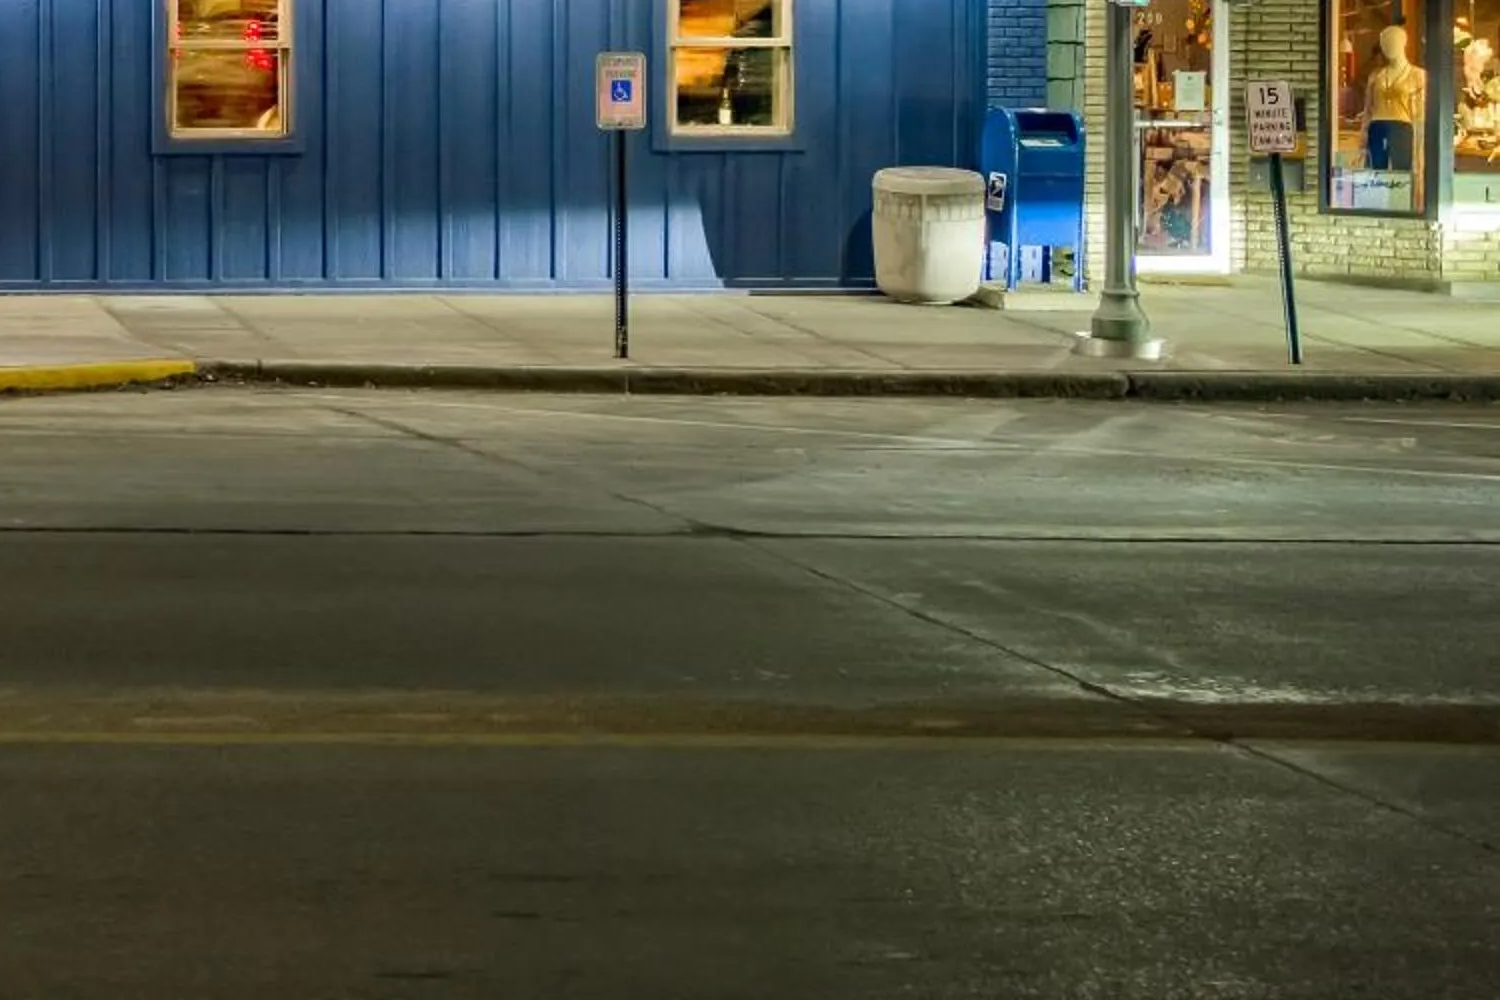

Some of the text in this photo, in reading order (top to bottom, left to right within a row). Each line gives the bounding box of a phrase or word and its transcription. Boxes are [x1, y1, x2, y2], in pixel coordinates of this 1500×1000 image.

[1259, 87, 1279, 105] 15
[1254, 107, 1288, 119] MINUTE
[1253, 121, 1291, 133] PARKING
